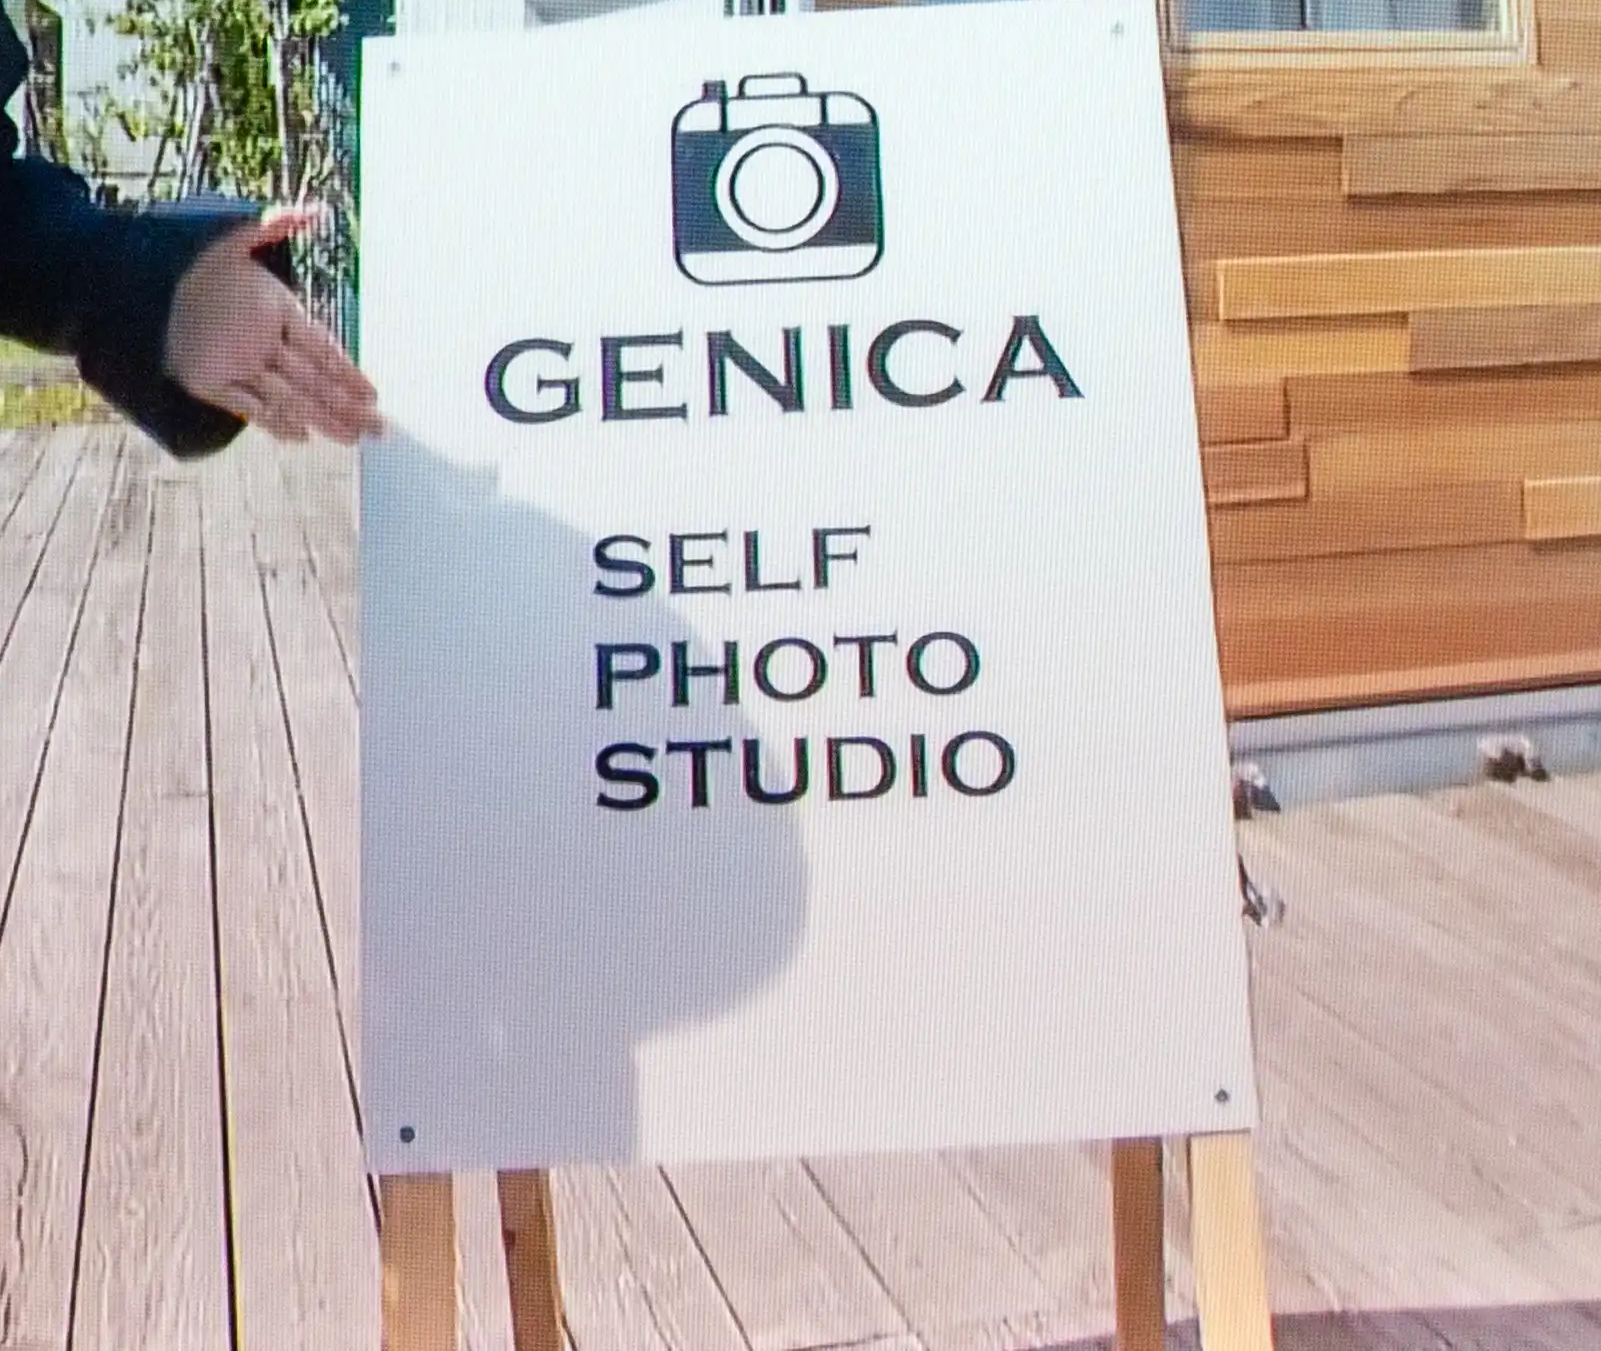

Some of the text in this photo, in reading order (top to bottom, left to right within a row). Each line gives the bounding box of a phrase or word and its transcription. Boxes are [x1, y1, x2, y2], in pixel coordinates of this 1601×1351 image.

[483, 314, 1086, 426] GENICA
[591, 523, 872, 599] SELF
[593, 629, 982, 711] PHOTO
[594, 728, 1017, 813] STUDIO
